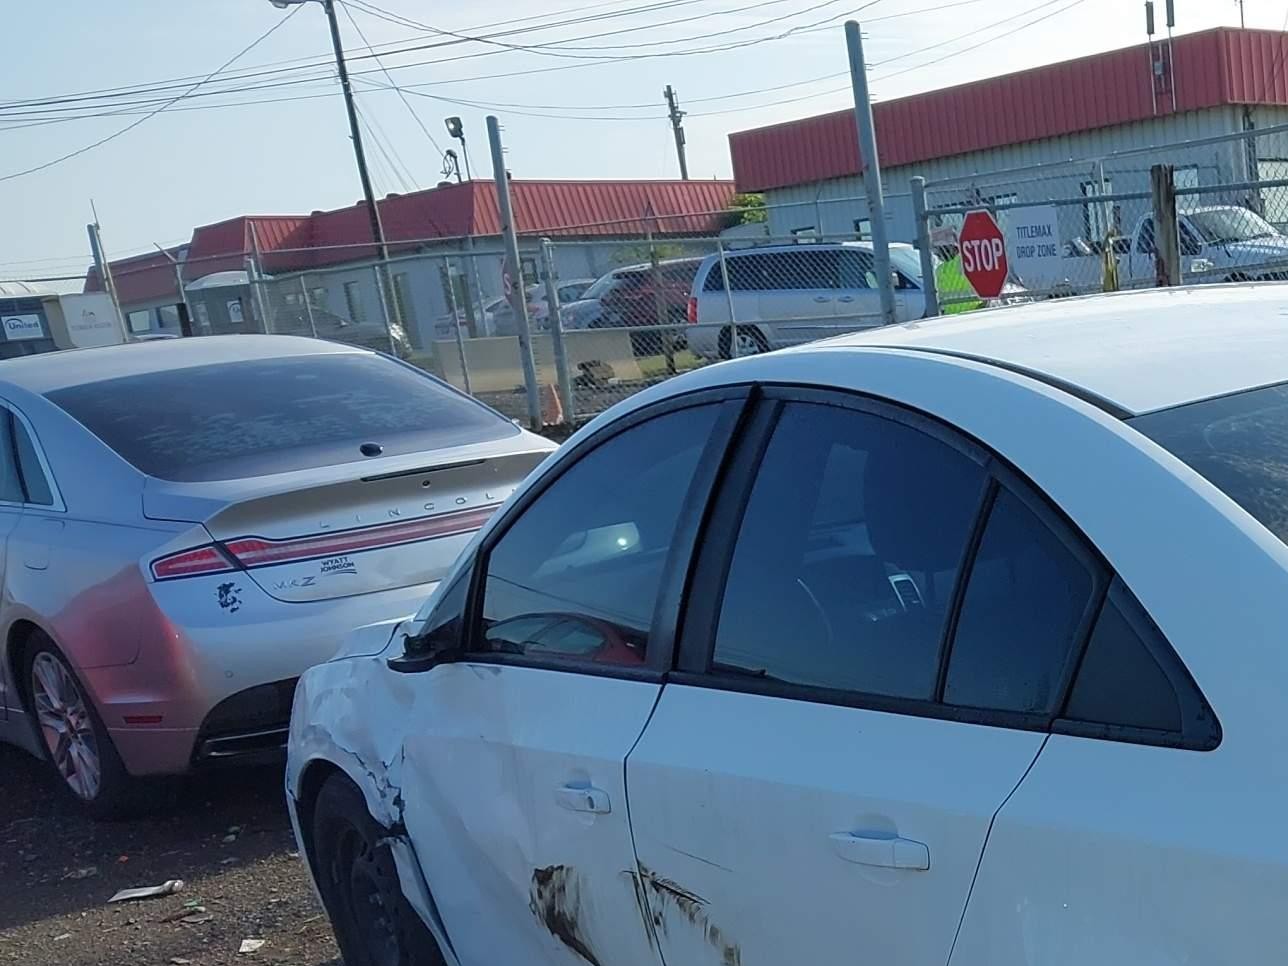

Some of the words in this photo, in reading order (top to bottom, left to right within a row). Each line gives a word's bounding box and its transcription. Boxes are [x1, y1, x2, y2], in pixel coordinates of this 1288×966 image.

[1016, 224, 1053, 239] TITLEMAX
[962, 238, 1003, 273] STOP
[1016, 245, 1036, 259] DROP
[1037, 244, 1057, 257] ZONE
[8, 320, 40, 330] United
[319, 488, 517, 529] LINCOL
[320, 562, 355, 573] JOHNSON
[321, 557, 349, 566] WYATT
